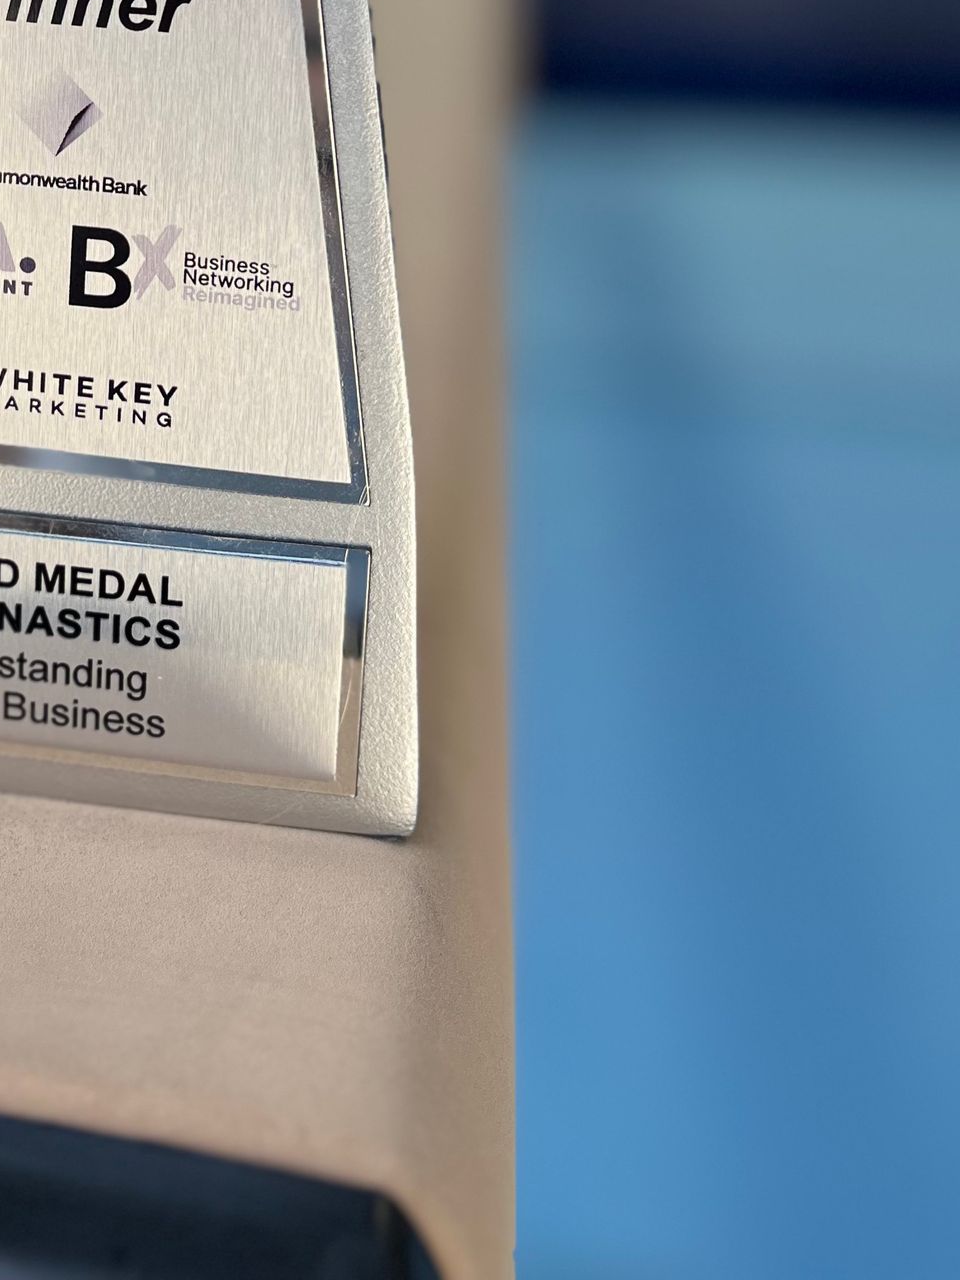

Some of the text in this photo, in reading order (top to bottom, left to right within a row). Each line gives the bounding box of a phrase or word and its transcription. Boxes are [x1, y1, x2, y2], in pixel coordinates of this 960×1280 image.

[102, 176, 148, 197] Bank
[183, 251, 270, 276] Business
[182, 269, 294, 298] Networking
[182, 284, 301, 312] Reimagined
[108, 379, 178, 407] KEY
[35, 562, 183, 607] MEDAL
[3, 691, 166, 738] Business
